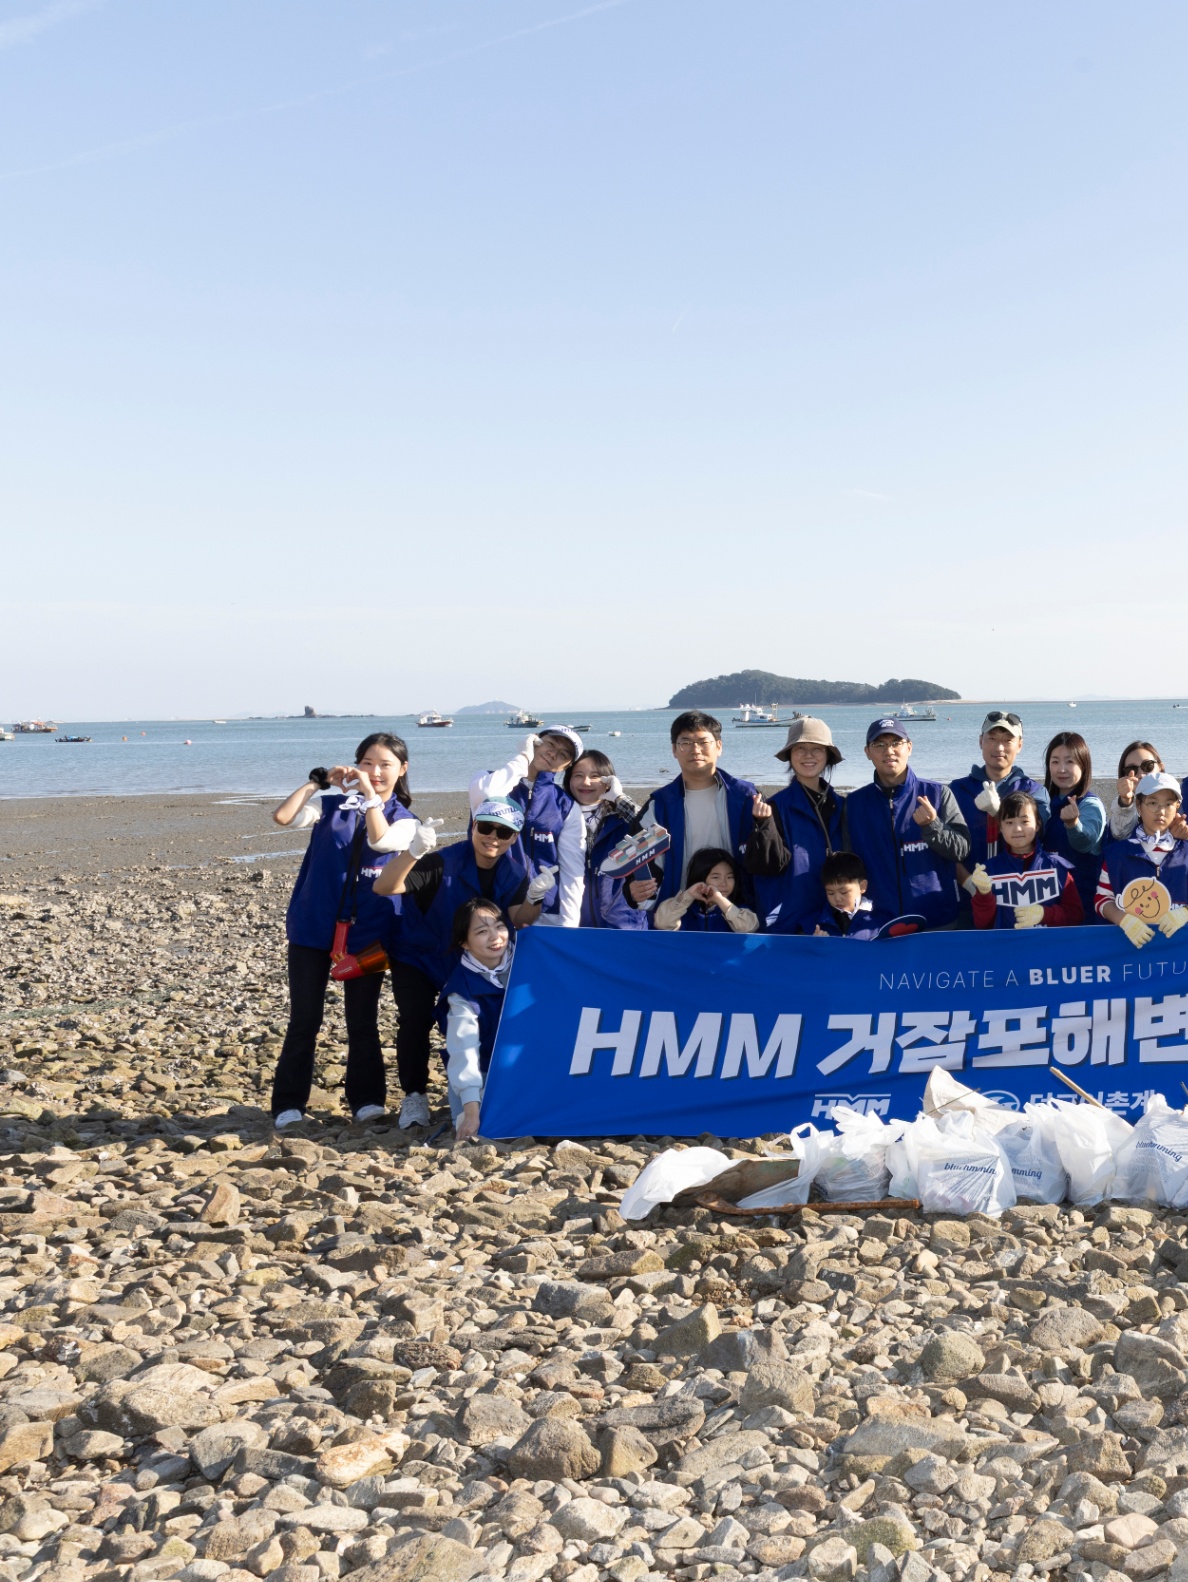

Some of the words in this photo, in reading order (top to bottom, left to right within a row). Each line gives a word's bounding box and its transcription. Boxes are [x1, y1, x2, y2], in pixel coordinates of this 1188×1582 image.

[635, 849, 656, 865] HMM
[991, 877, 1057, 906] HMM
[879, 970, 995, 990] NAVIGATE
[1005, 969, 1019, 987] A
[1029, 965, 1111, 986] BLUER
[569, 1007, 801, 1079] HMM
